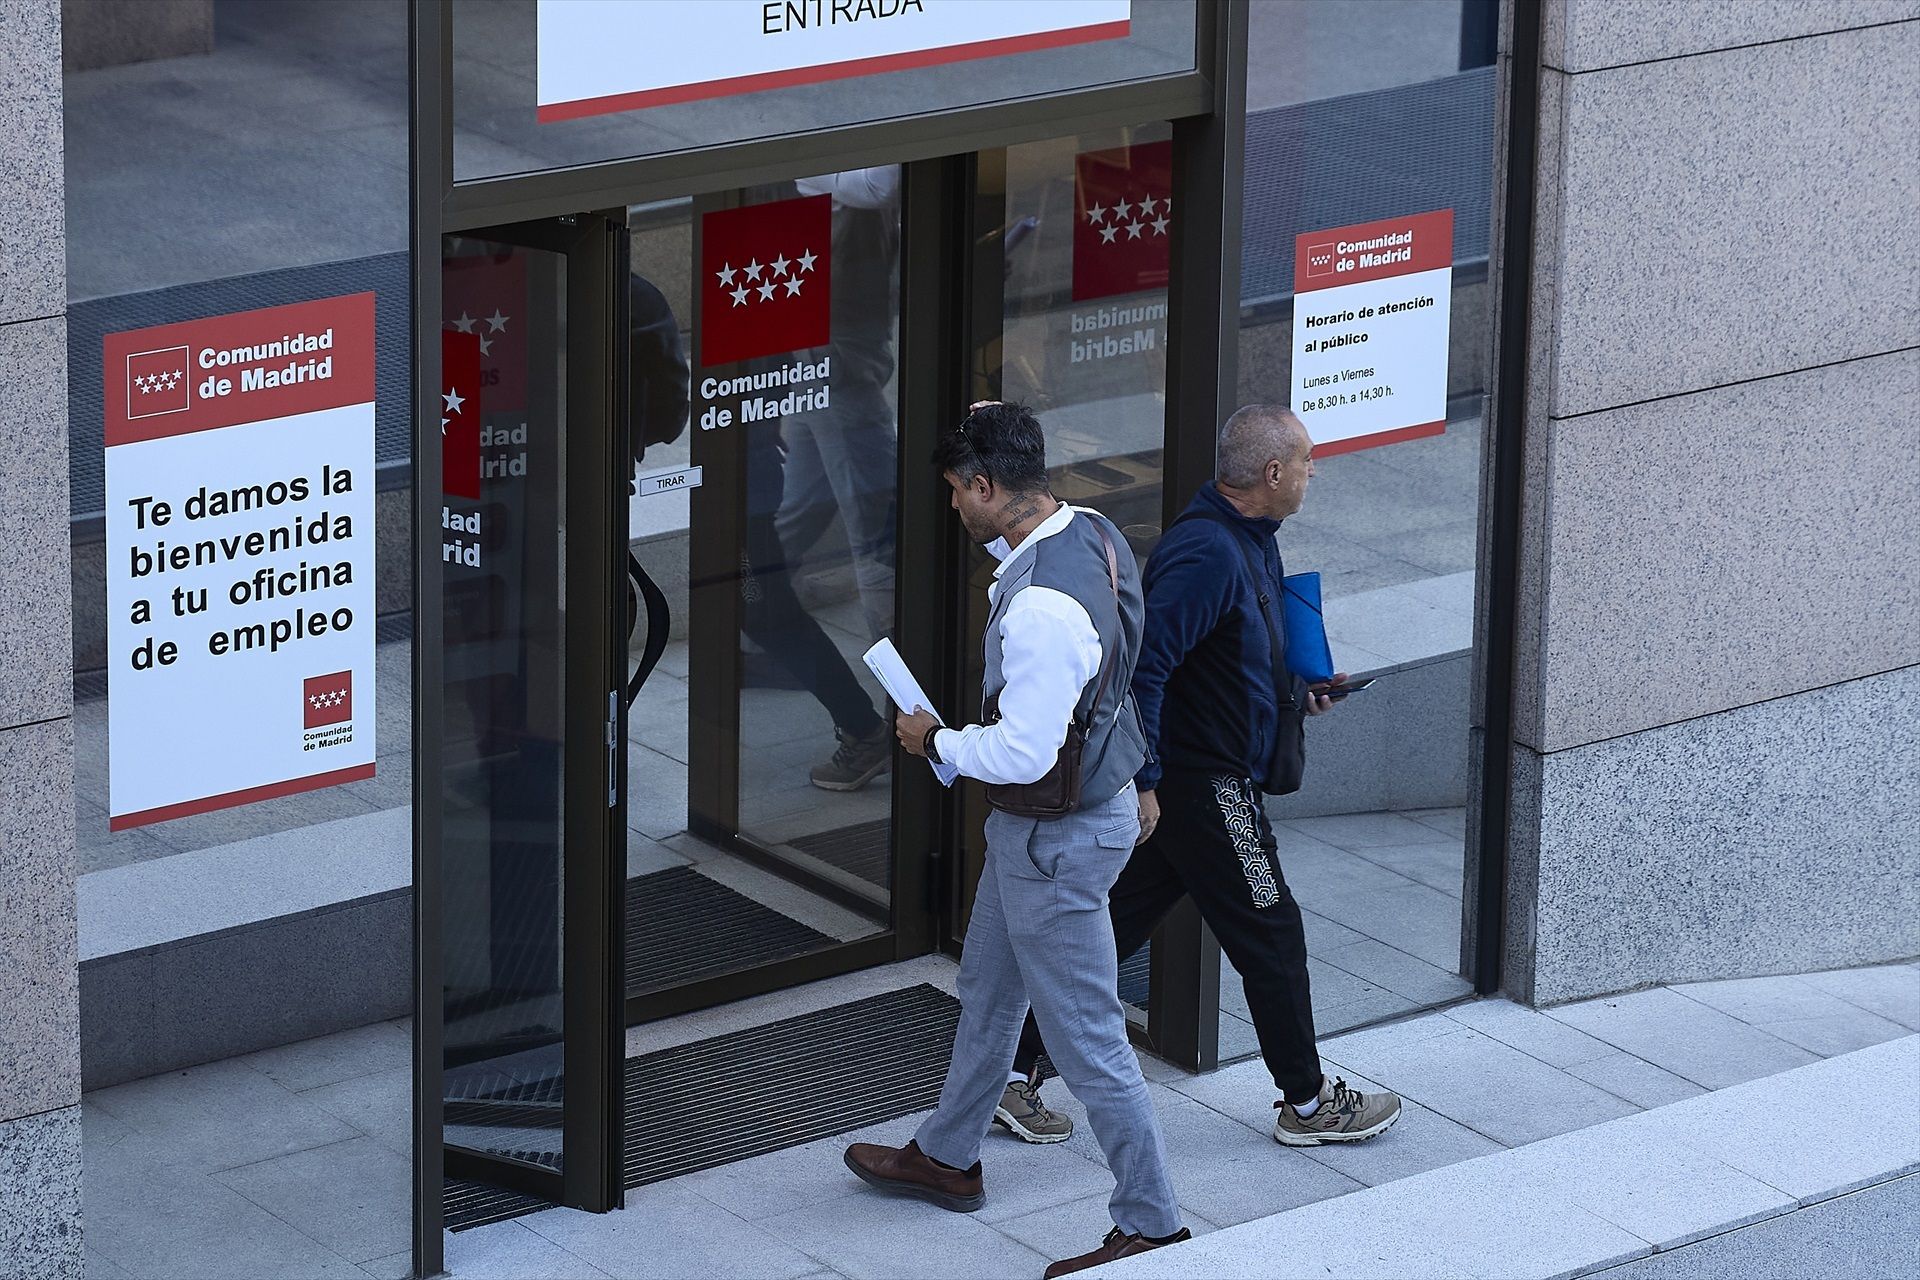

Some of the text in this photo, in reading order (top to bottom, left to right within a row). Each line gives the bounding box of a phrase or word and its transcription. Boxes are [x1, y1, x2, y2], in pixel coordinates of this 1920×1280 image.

[1337, 230, 1412, 255] Comunidad
[1336, 247, 1411, 272] de Madrid
[1306, 296, 1434, 328] Horario de atención
[198, 328, 333, 369] Comunidad
[1305, 333, 1368, 352] al público
[198, 356, 332, 399] de Madrid
[700, 357, 830, 399] Comunidad
[1303, 367, 1375, 388] Lunes a Viernes
[700, 385, 830, 431] de Madrid
[1302, 385, 1394, 412] De 8,30 h. a 14,30 h.
[128, 464, 353, 530] Te damos la
[656, 475, 685, 489] TIRAR
[130, 511, 353, 577] bienvenida
[130, 561, 353, 624] a tu oficina
[131, 607, 353, 670] de empleo
[303, 724, 353, 741] Comunidad
[303, 734, 353, 751] de Madrid
